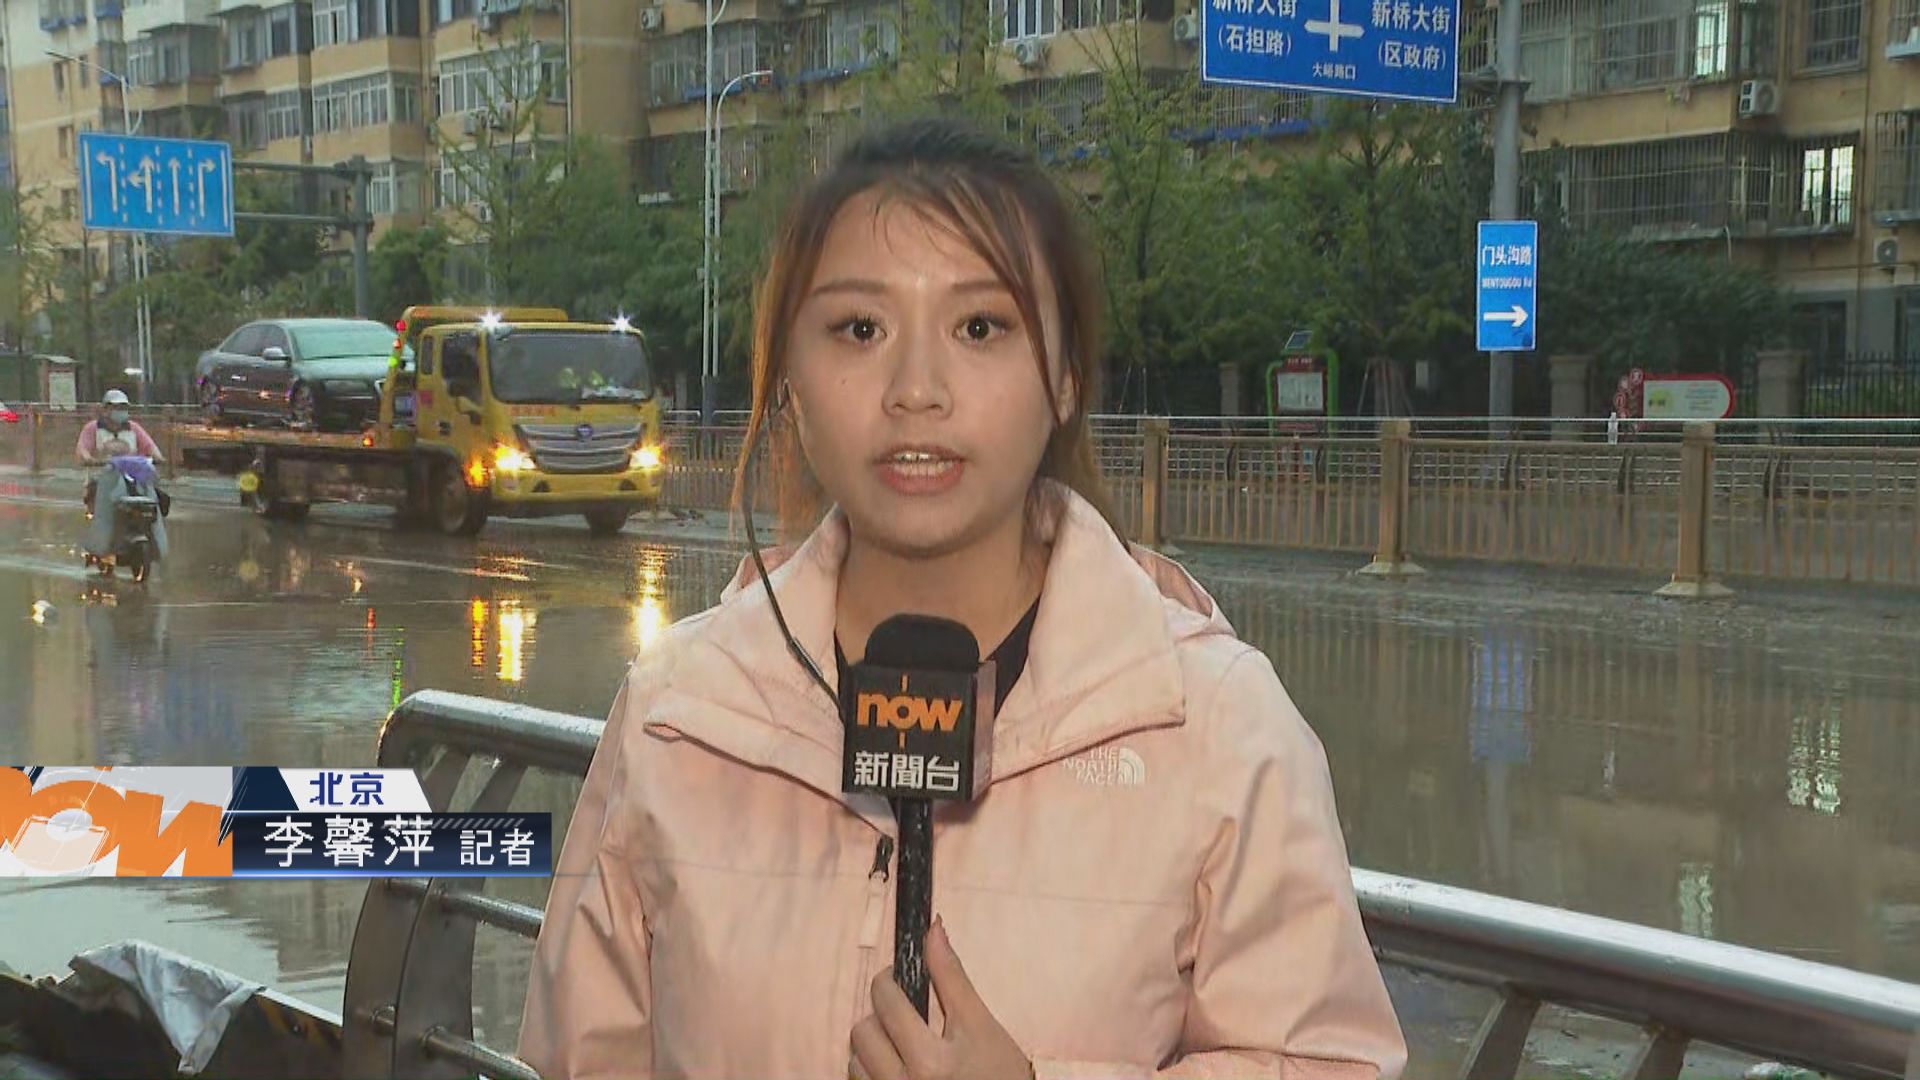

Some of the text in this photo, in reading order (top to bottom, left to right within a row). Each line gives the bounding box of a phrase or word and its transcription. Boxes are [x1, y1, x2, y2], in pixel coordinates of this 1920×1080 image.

[1372, 0, 1450, 34] 新桥大街
[1482, 244, 1532, 266] 门头沟路
[856, 691, 963, 732] now
[1063, 758, 1118, 772] NORTH
[1090, 745, 1118, 759] THE
[853, 750, 960, 792] 新聞台
